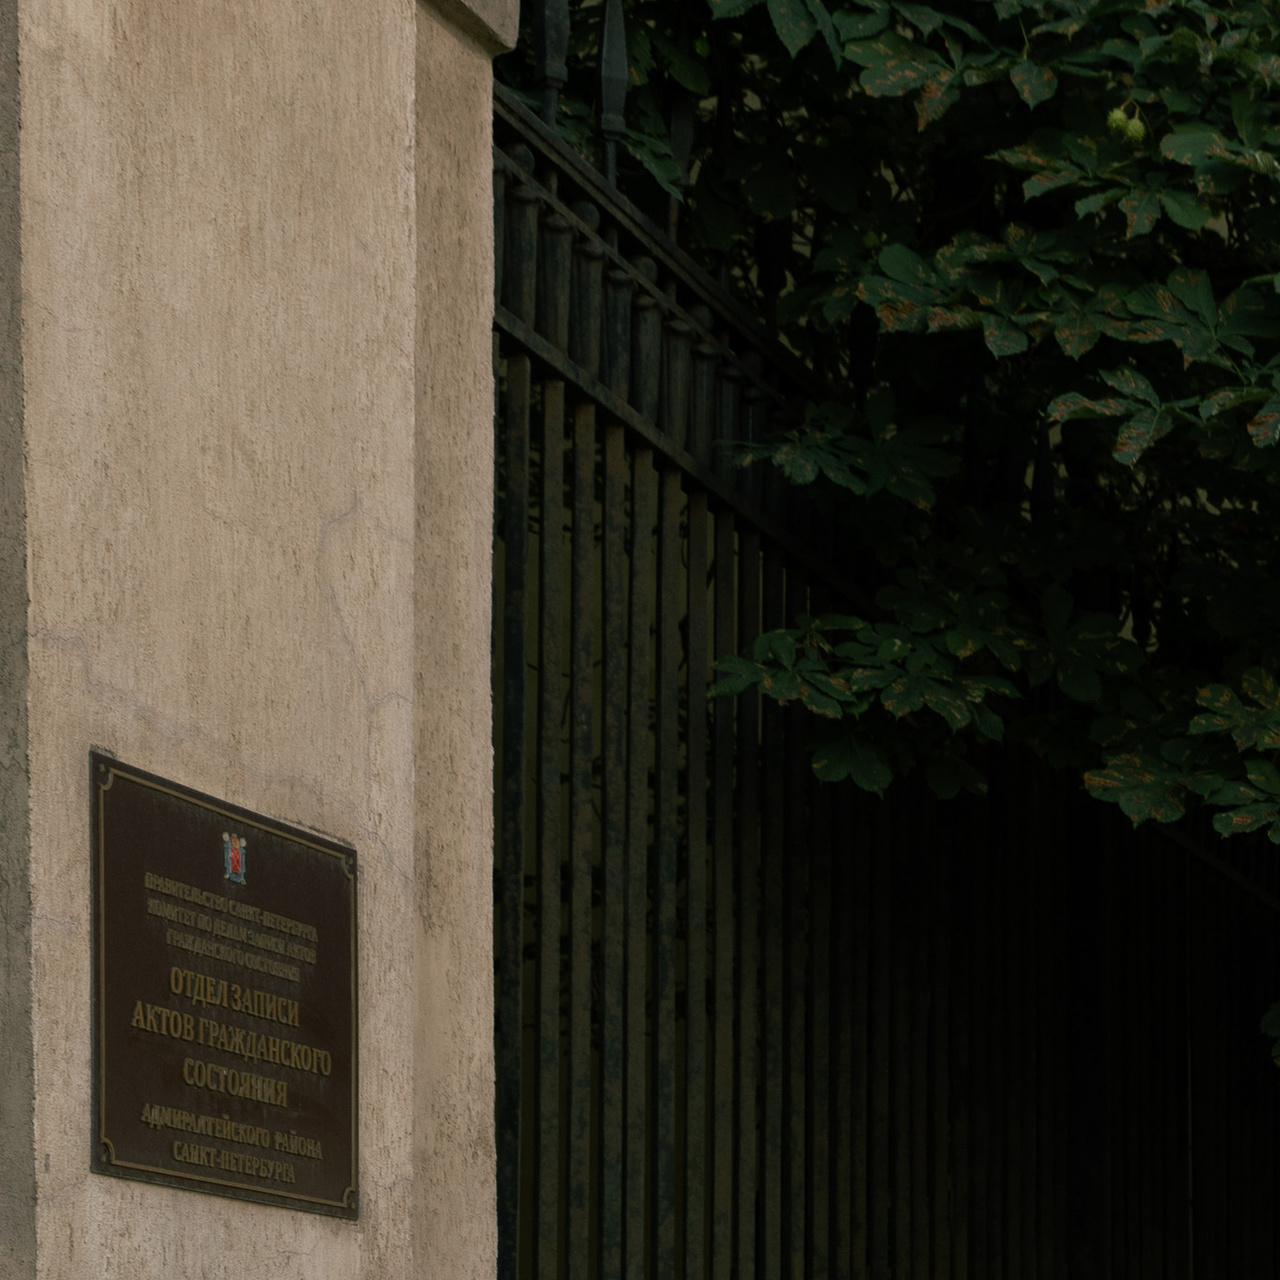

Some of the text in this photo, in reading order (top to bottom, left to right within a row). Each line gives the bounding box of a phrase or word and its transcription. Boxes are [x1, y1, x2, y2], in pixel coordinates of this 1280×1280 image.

[144, 871, 319, 943] ПРАВИТЕЛЬСТВО САНКТ-ПЕТЕРБУРГА
[147, 897, 196, 931] КОМИТЕТ
[196, 913, 212, 932] ПО
[248, 929, 285, 955] ЗАПИСИ
[286, 942, 317, 965] АКТОВ
[166, 928, 301, 983] ГРАЖДАНСКОГО СОСТОЯНИЯ
[170, 966, 300, 1028] ОТДЕЛ ЗАПИСИ
[131, 1000, 332, 1076] АКТОВ ГРАЖДАНСКОГО
[182, 1057, 288, 1108] СОСТОЯНИЯ
[140, 1102, 323, 1160] АДМИРАЛТЕЙСКОГО РАЙОНА
[173, 1140, 296, 1184] САНКТ-ПЕТЕРБУРГА
